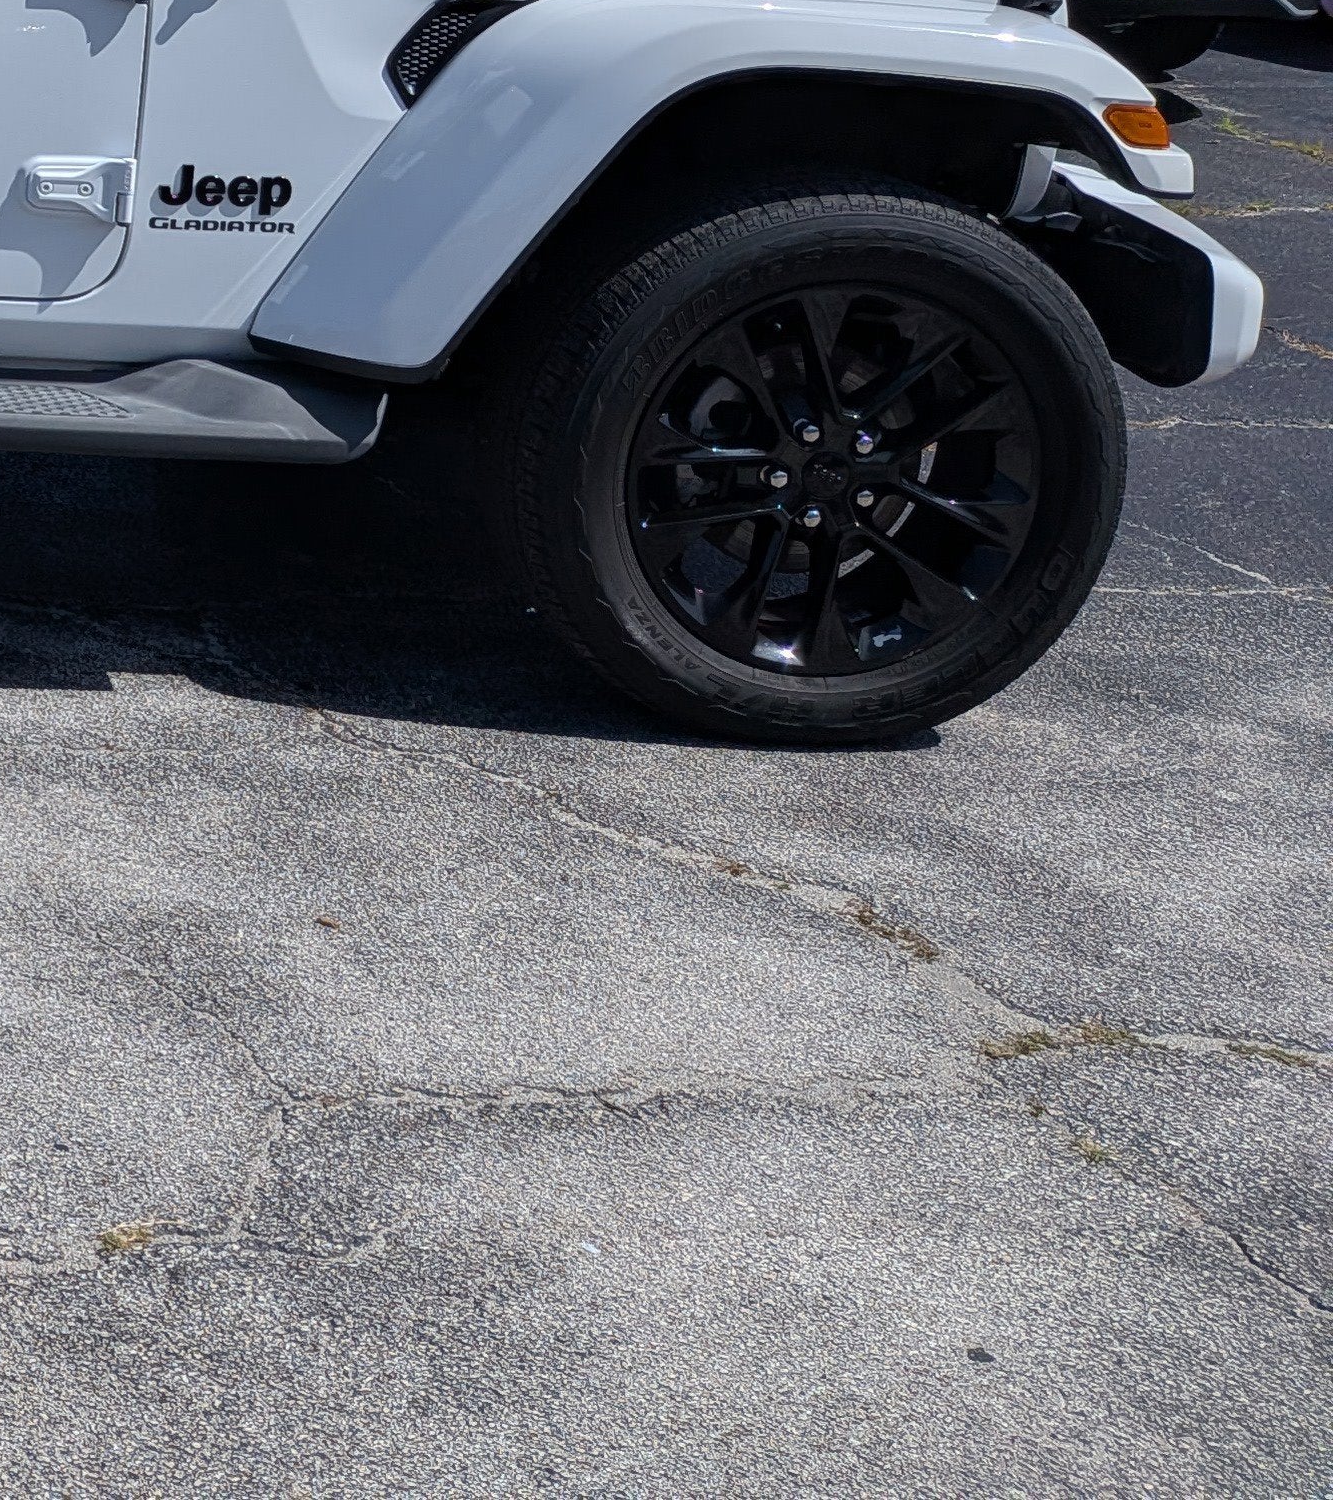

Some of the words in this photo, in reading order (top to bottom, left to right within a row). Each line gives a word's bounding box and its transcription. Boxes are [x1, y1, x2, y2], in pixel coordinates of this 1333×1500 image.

[157, 163, 293, 216] Jeep
[148, 216, 296, 235] GLADIATOR
[624, 596, 702, 672] ALENZA
